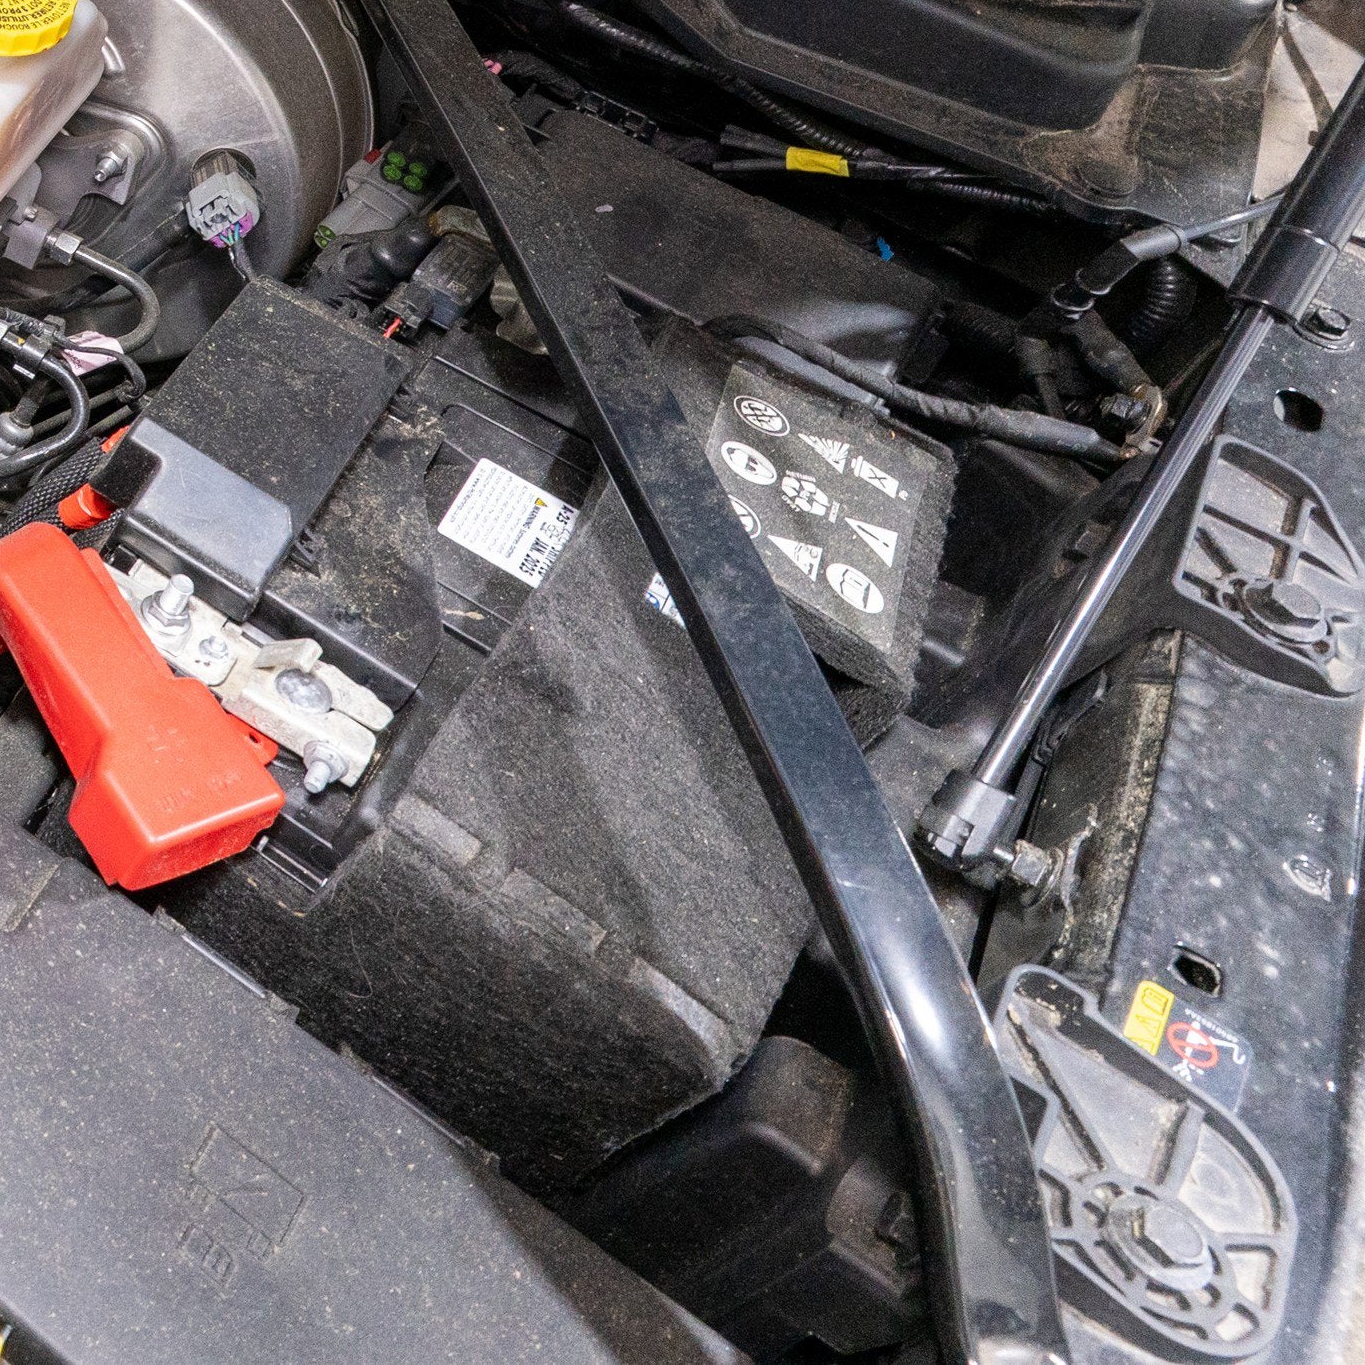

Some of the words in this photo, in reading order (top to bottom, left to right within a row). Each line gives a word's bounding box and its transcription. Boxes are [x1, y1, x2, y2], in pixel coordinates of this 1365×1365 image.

[556, 504, 575, 526] A-25
[529, 537, 550, 556] JAN.
[518, 553, 540, 577] 2025
